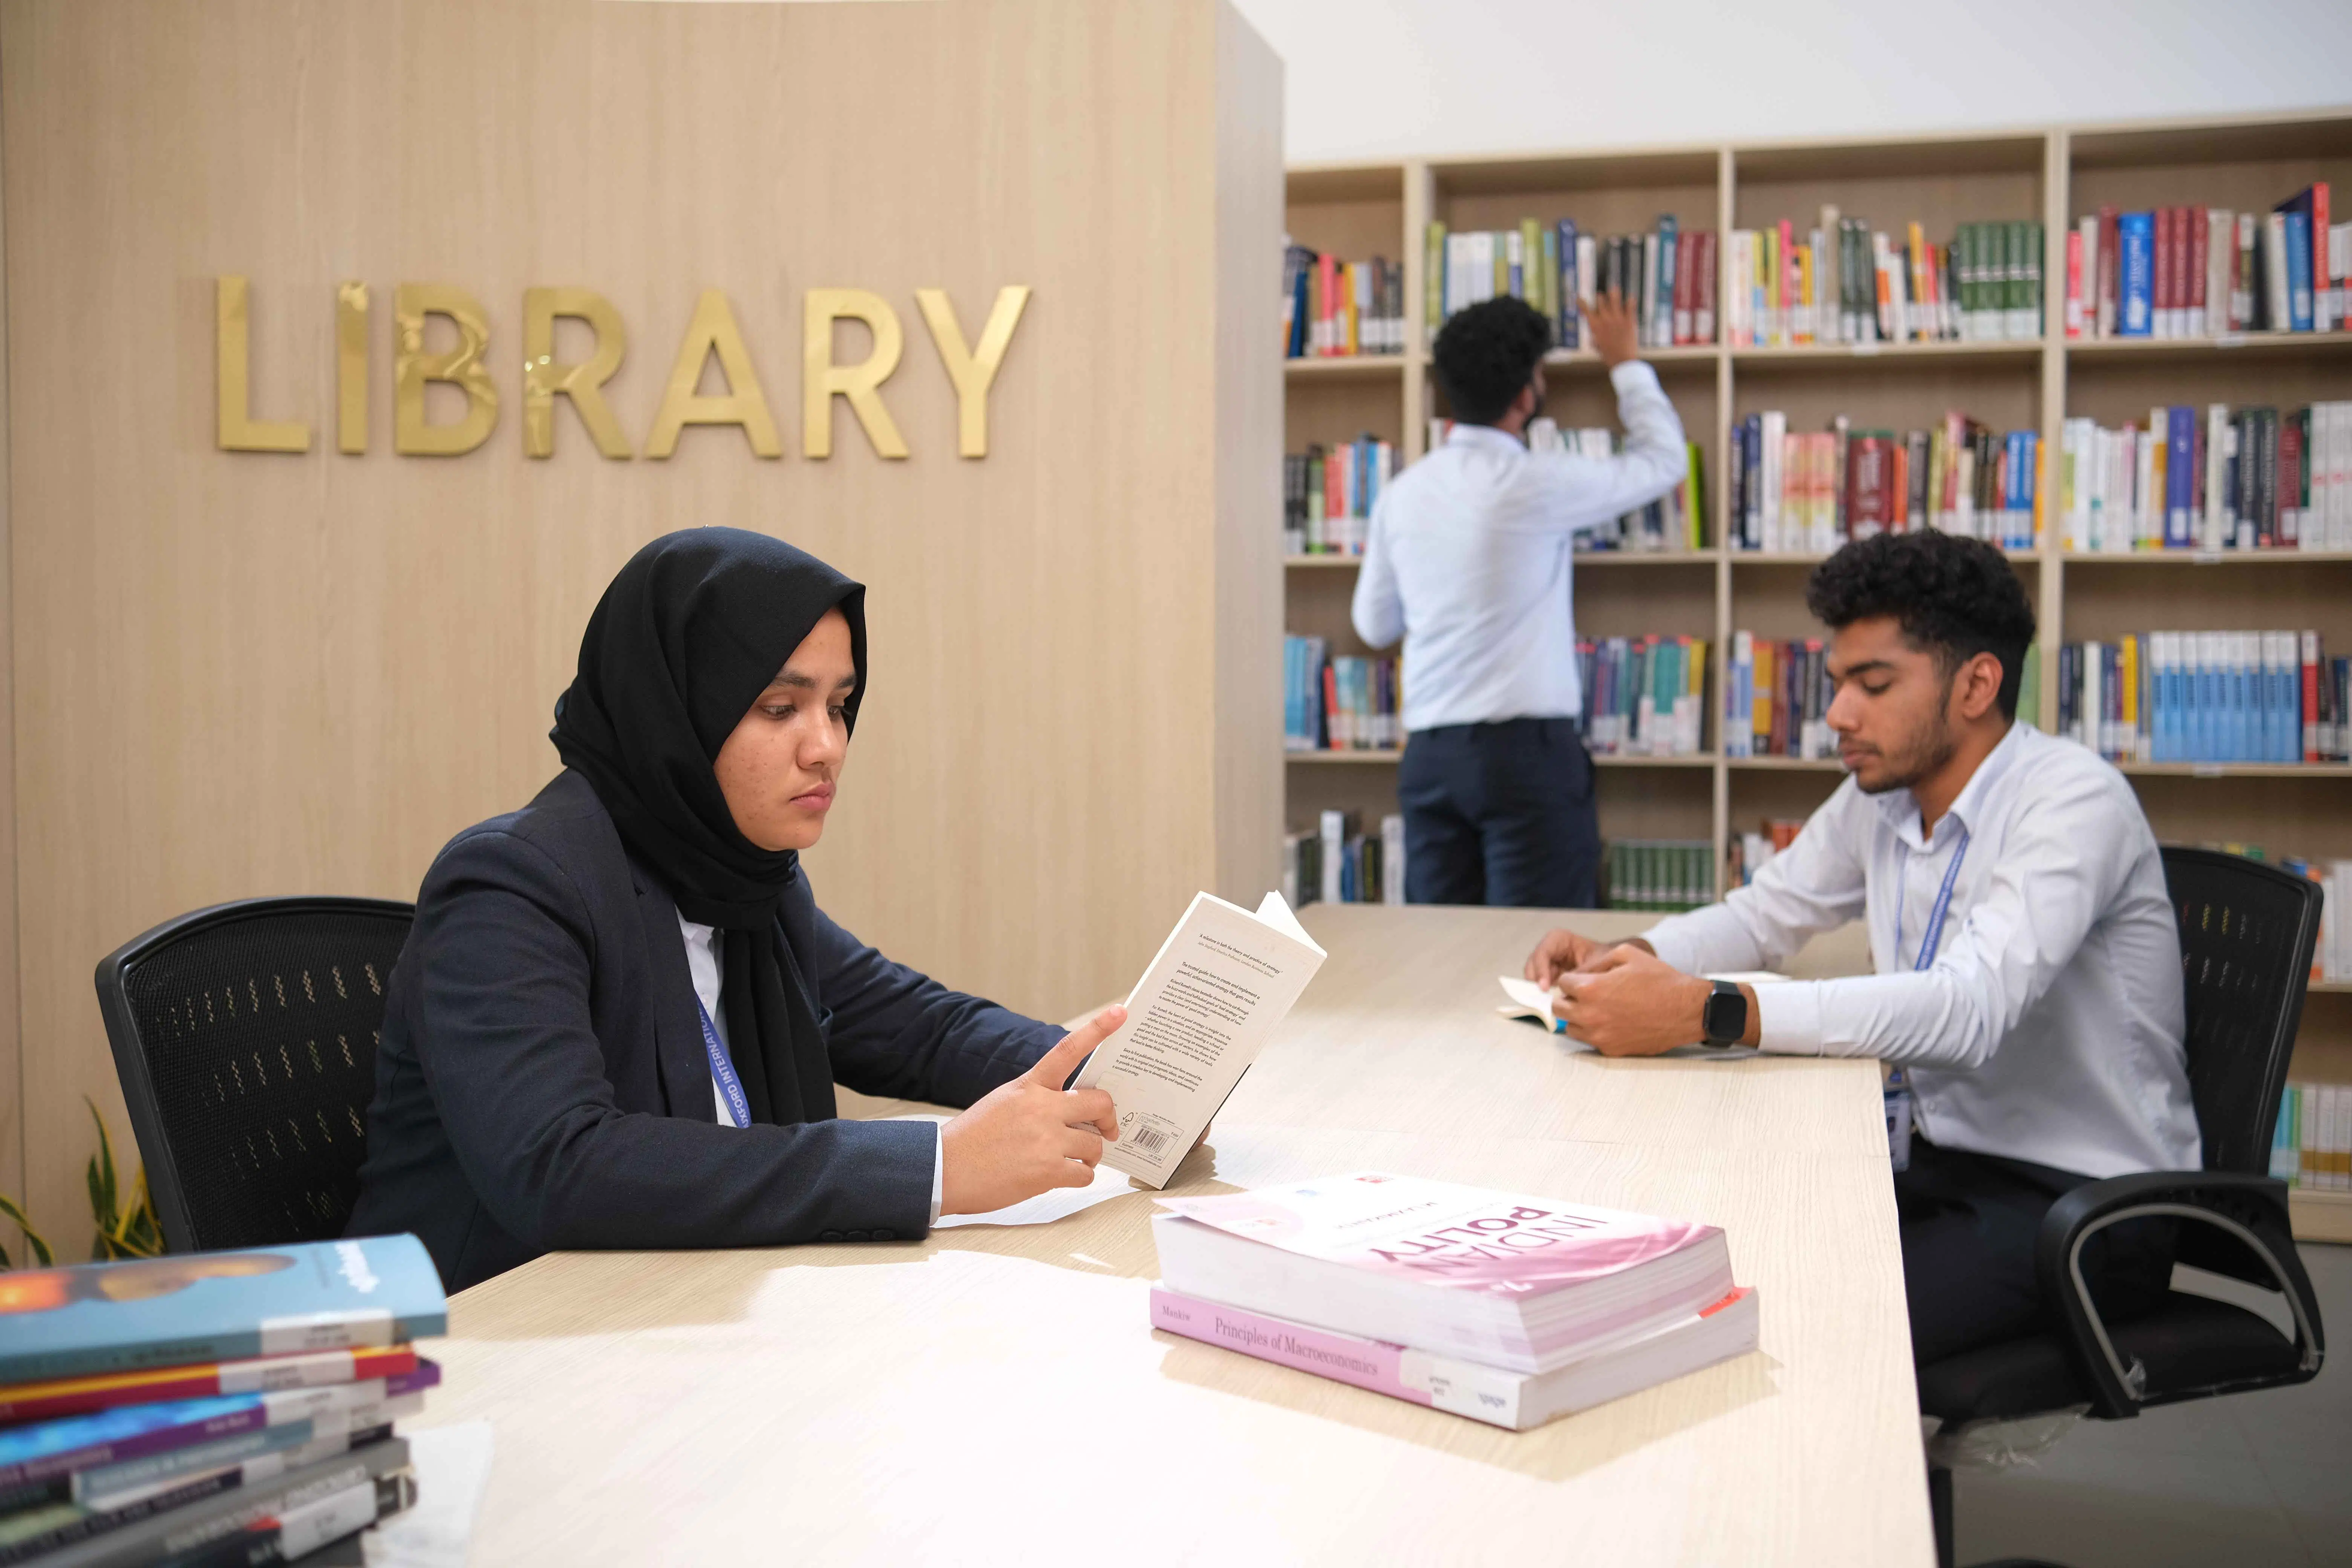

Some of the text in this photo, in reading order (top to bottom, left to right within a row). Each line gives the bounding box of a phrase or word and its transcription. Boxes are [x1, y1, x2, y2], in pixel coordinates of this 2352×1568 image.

[217, 274, 1032, 461] LIBRARY
[1238, 986, 1257, 997] implement
[1209, 1009, 1230, 1021] understanding
[1194, 1035, 1206, 1043] heading
[1152, 1072, 1168, 1080] developing
[1368, 1207, 1553, 1263] POLITY
[1405, 1215, 1609, 1274] INDIAN
[1162, 1305, 1191, 1321] Mankiw
[1215, 1317, 1378, 1376] Principles of Macroeconomics
